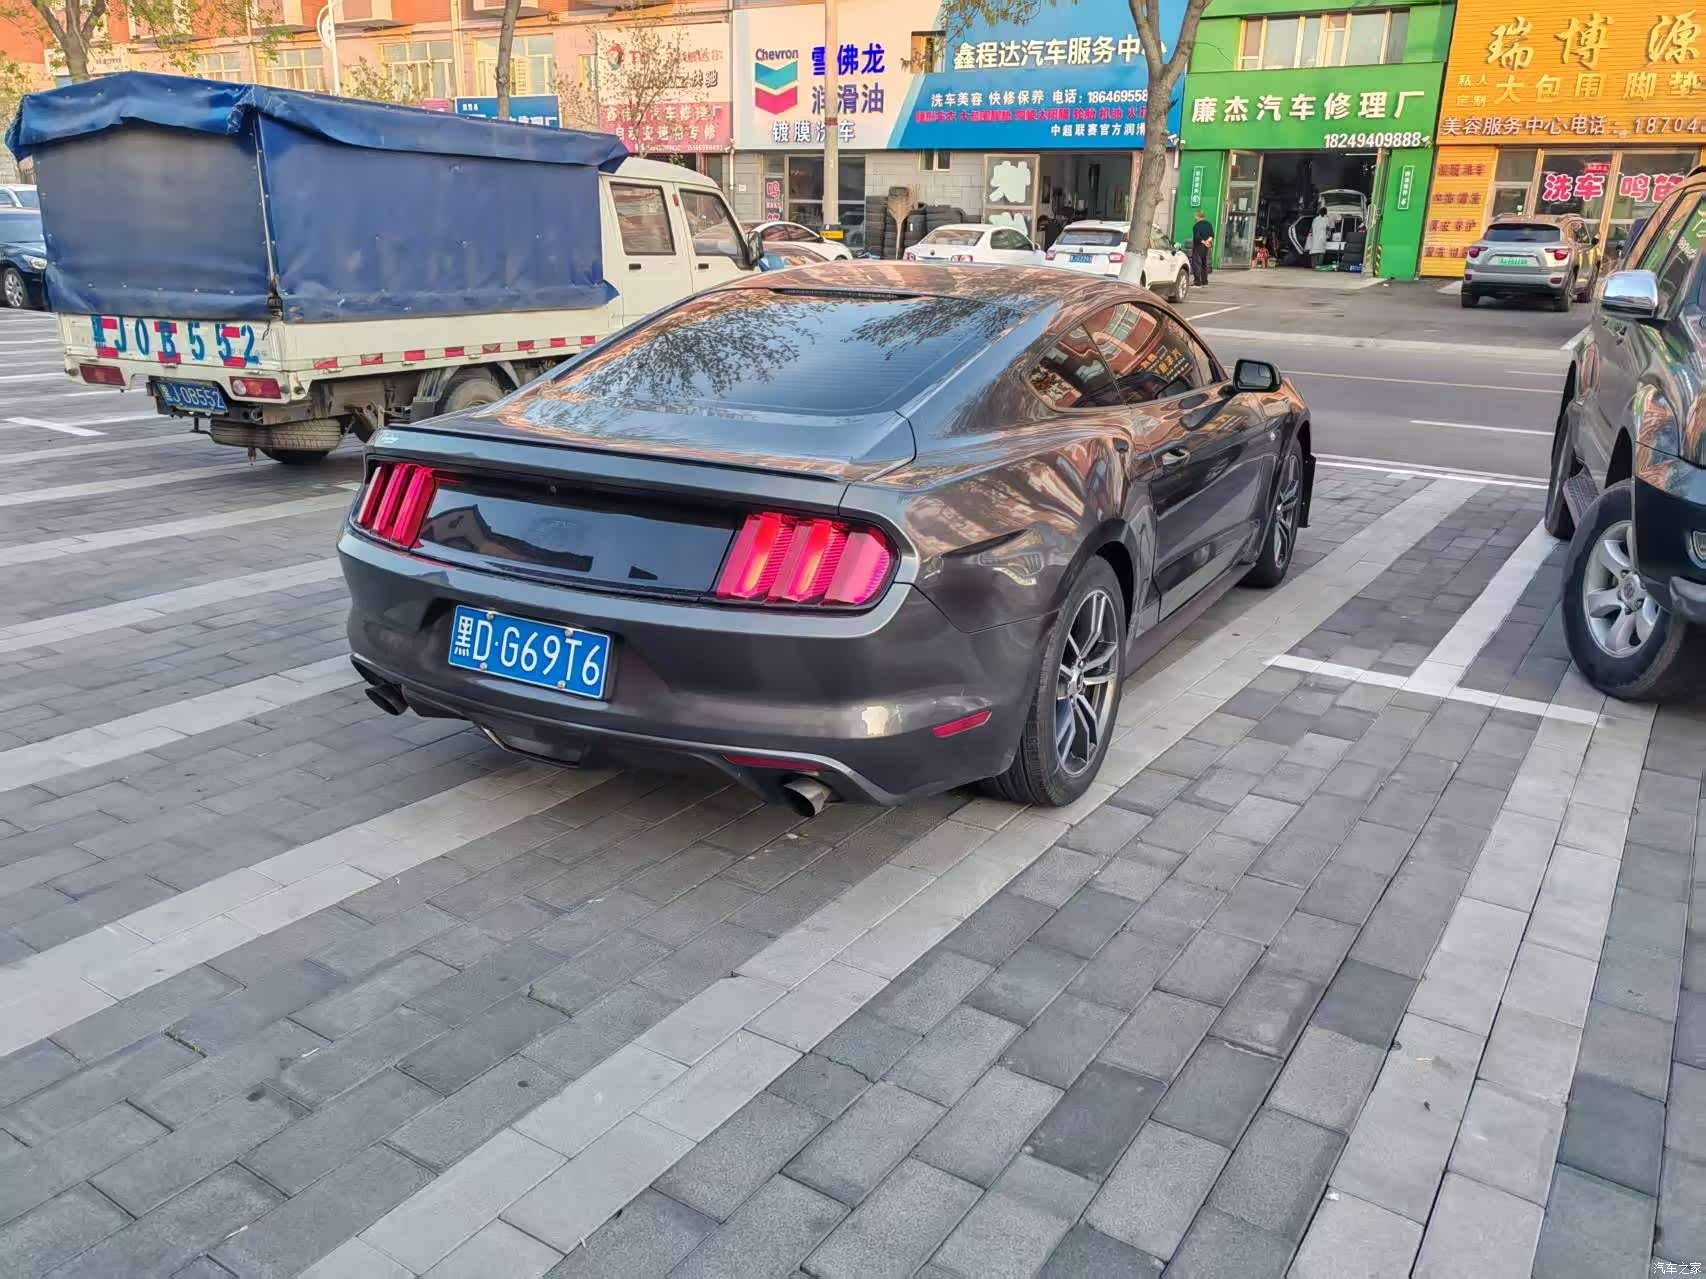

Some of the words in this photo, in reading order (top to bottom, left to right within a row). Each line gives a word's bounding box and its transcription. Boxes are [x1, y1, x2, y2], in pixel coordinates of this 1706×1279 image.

[755, 48, 799, 61] Chevron
[1486, 9, 1703, 71] 瑞博源
[811, 43, 885, 76] 雪佛龙
[811, 82, 885, 114] 润滑油
[931, 92, 983, 107] 洗车美容
[988, 89, 1045, 105] 快修保养
[1191, 90, 1425, 123] 廉杰汽车修理厂
[1324, 131, 1422, 149] 18249409888
[1634, 116, 1706, 134] 18704
[1542, 173, 1605, 202] 洗车
[1619, 173, 1686, 203] 鸣笛
[453, 615, 601, 686] 黑D·G69T6
